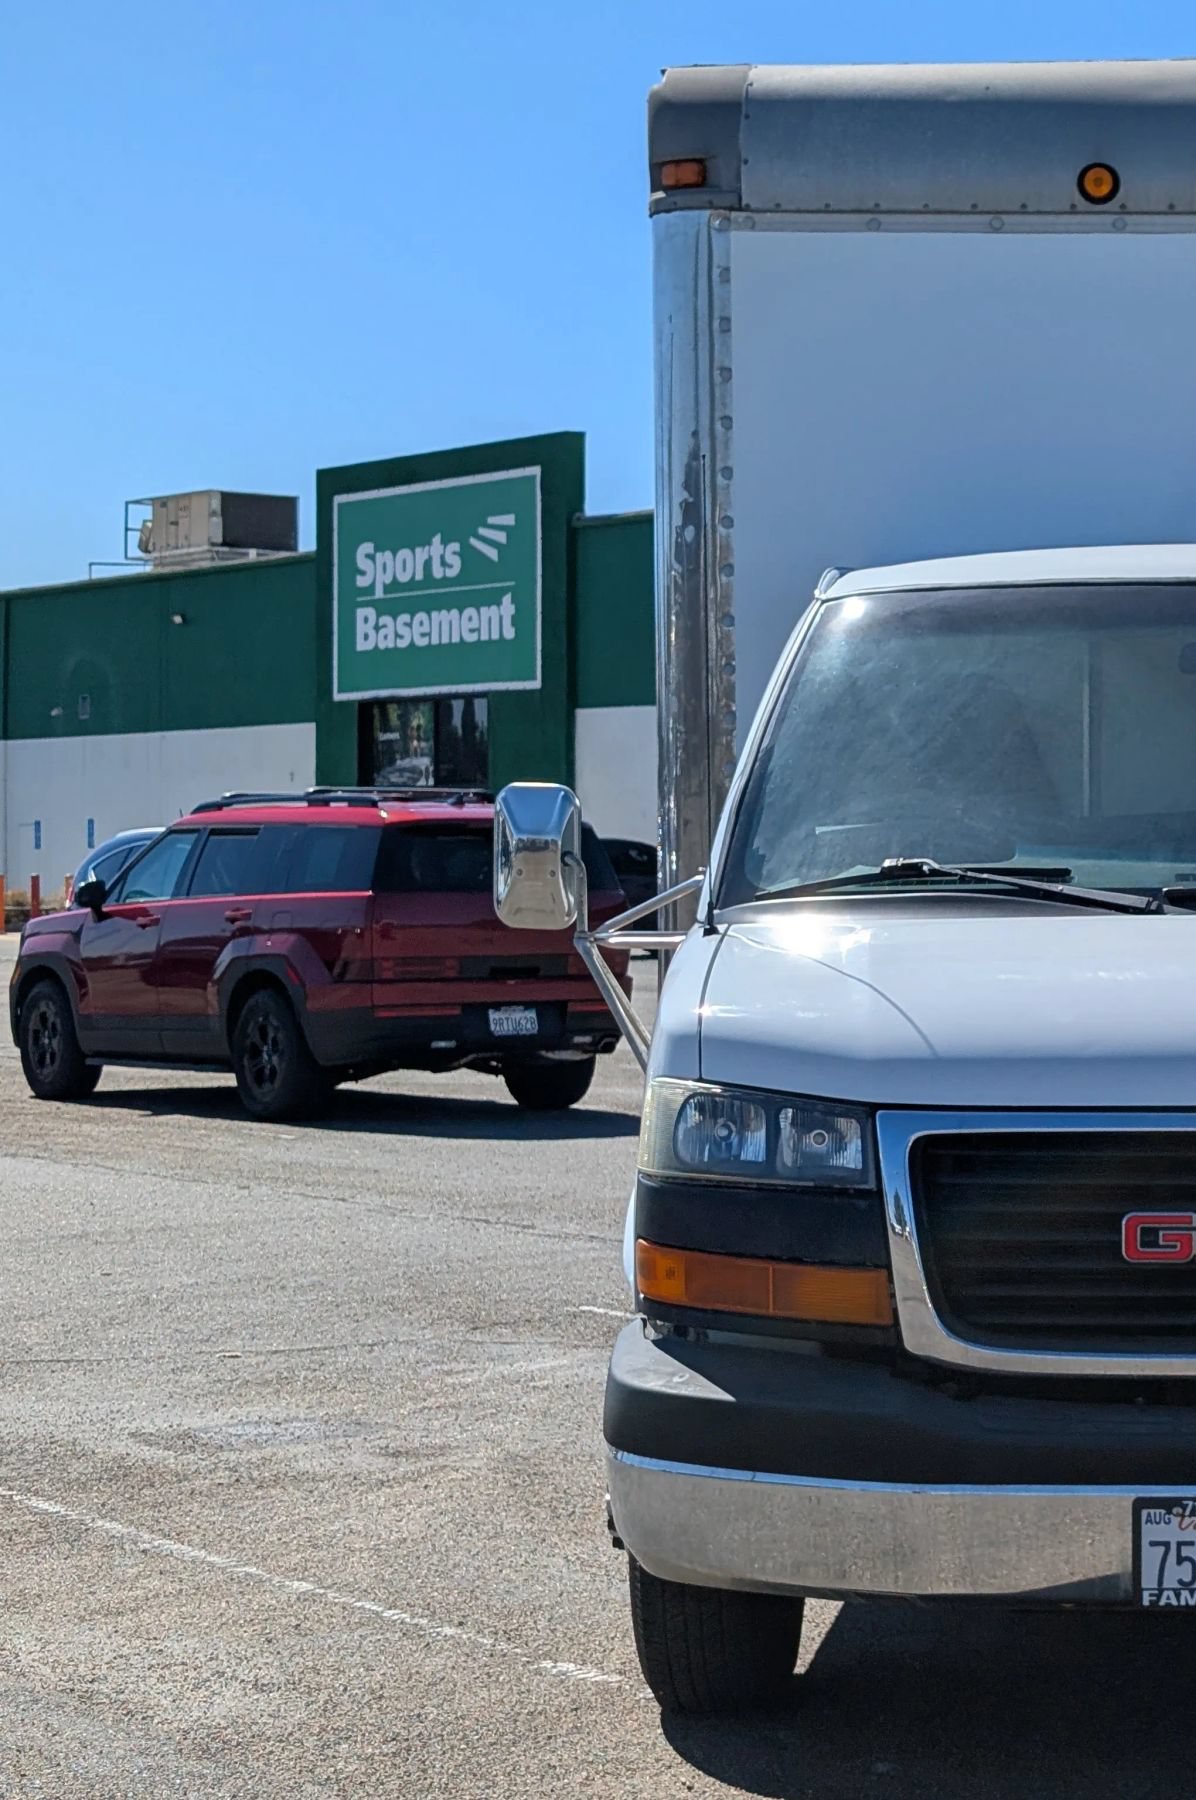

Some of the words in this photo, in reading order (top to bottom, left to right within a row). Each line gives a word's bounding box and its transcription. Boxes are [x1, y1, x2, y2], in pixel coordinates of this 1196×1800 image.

[356, 533, 461, 597] Sports
[356, 592, 516, 651] Basement
[1144, 1511, 1172, 1525] AUG
